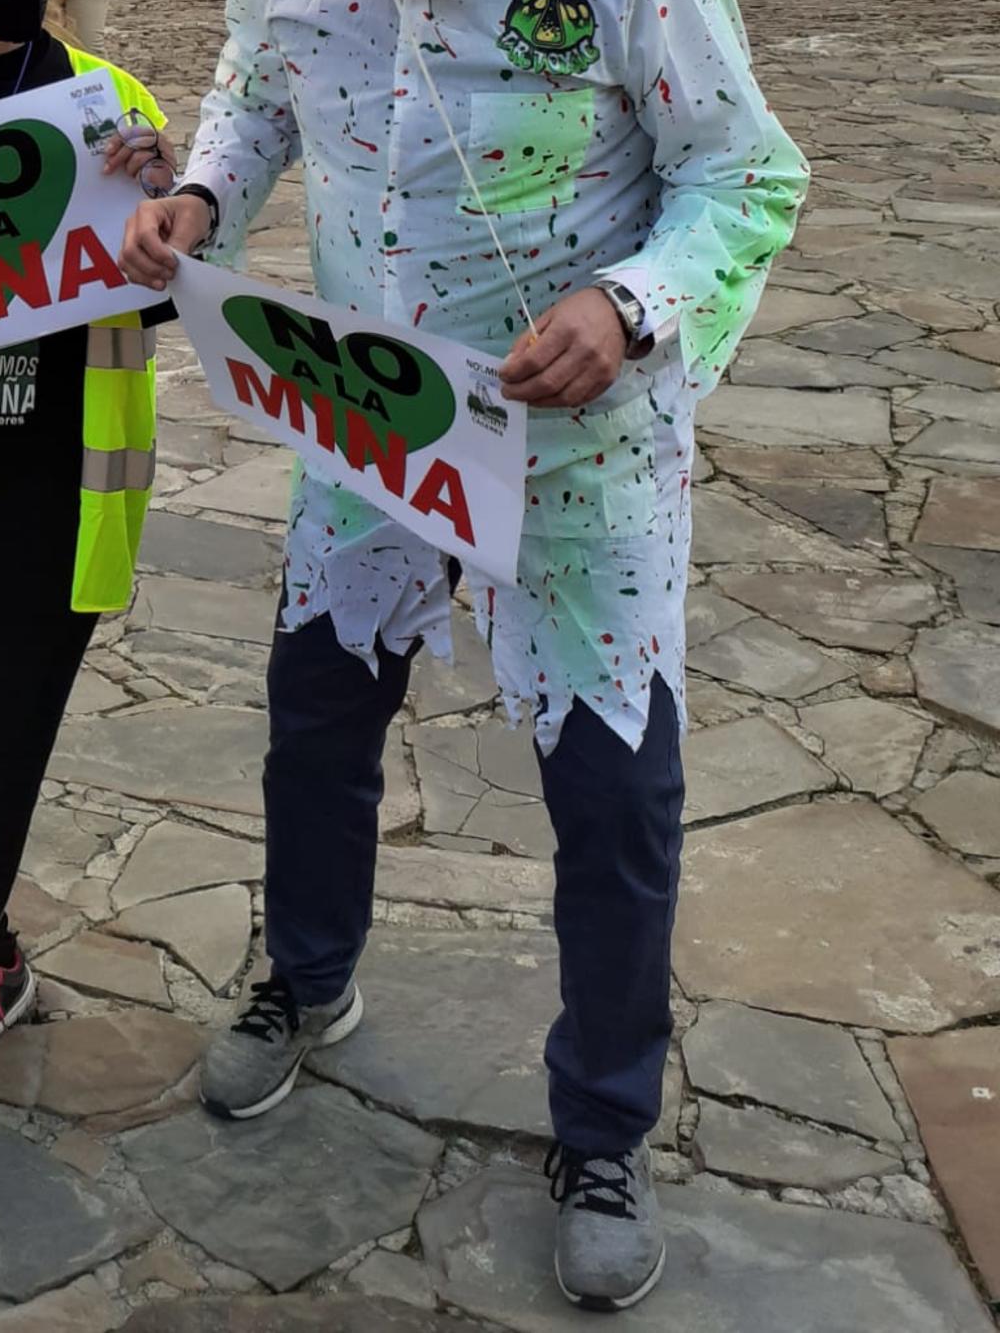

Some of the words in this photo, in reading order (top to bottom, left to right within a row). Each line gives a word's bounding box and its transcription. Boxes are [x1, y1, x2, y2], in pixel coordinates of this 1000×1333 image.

[260, 301, 422, 396] NO
[292, 358, 322, 386] A
[335, 372, 391, 422] LA
[225, 357, 476, 547] MINA
